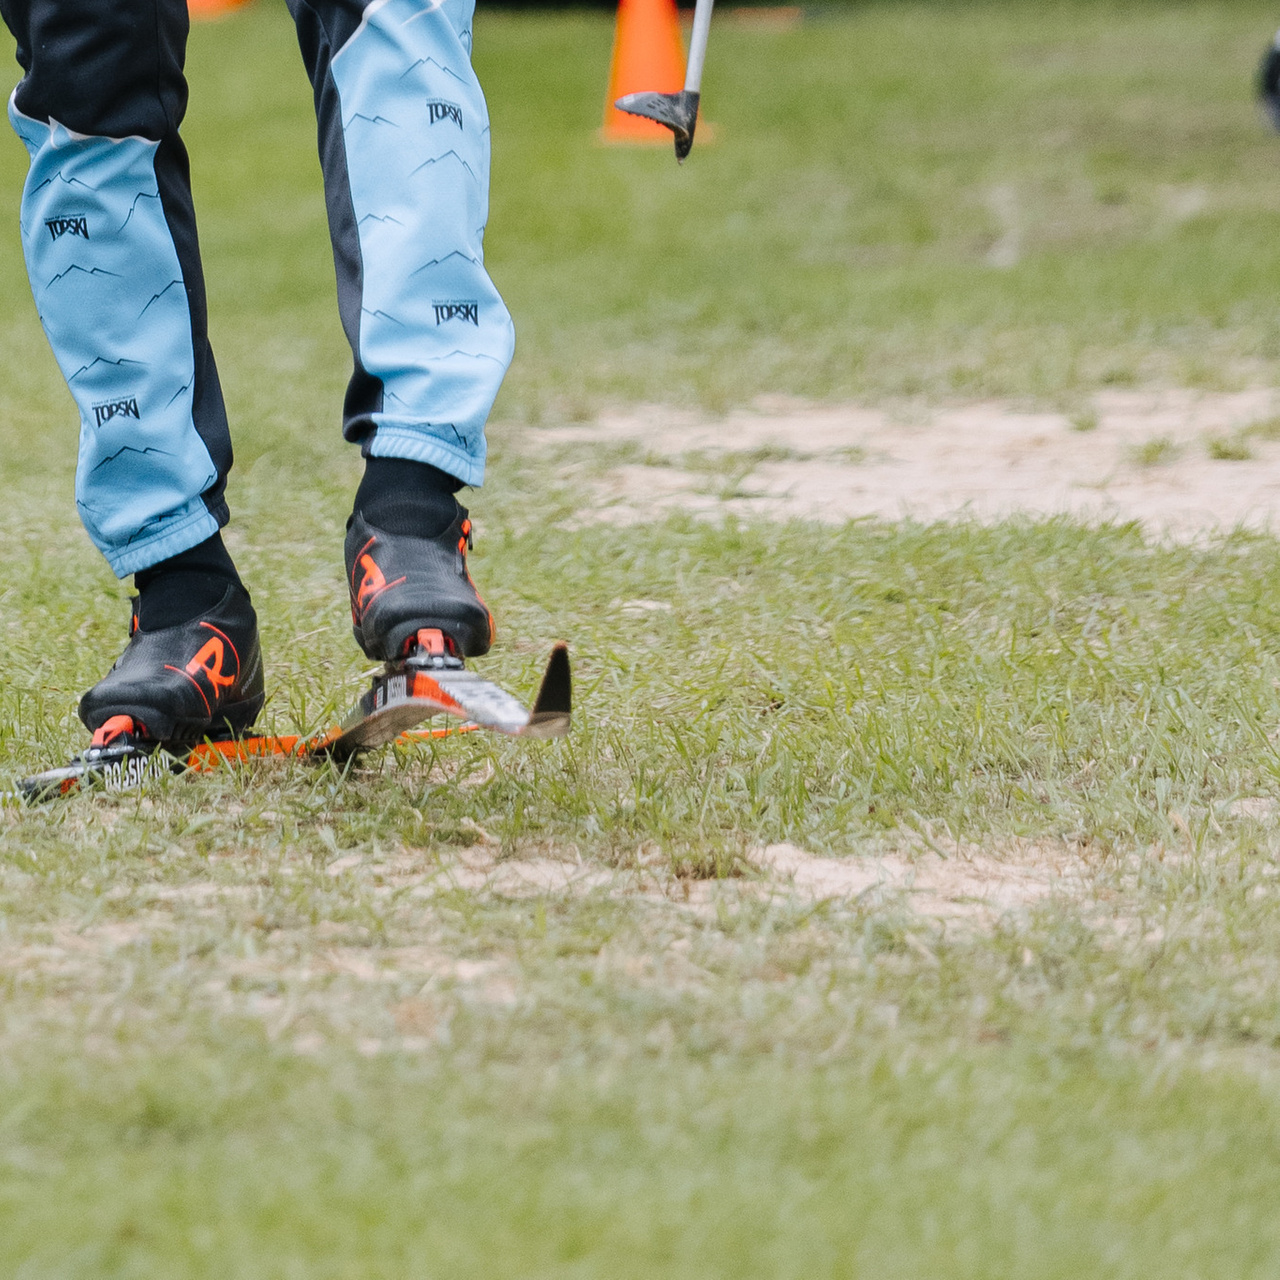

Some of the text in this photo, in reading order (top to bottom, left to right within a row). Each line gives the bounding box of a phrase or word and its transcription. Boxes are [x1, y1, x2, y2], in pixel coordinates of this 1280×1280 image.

[45, 217, 89, 241] TOPSKI
[432, 304, 478, 326] TOPSKI
[92, 398, 140, 428] TOPSKI
